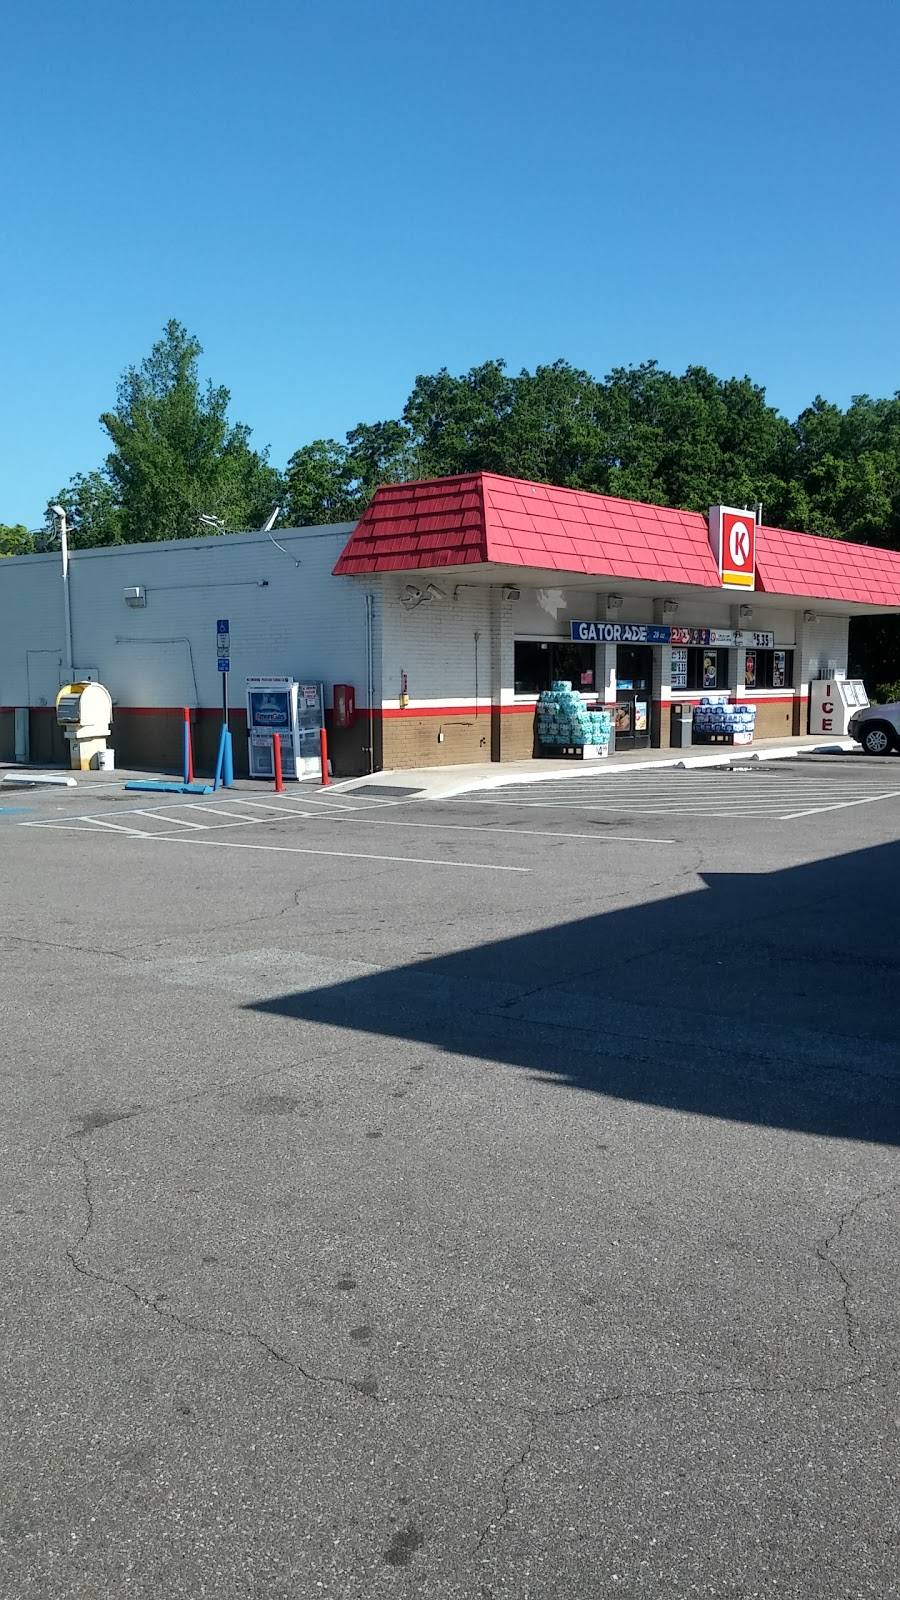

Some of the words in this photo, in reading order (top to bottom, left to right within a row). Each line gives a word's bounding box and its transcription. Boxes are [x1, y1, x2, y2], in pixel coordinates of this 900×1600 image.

[735, 531, 747, 560] K
[579, 622, 647, 641] GATORADE
[821, 684, 834, 731] ICE
